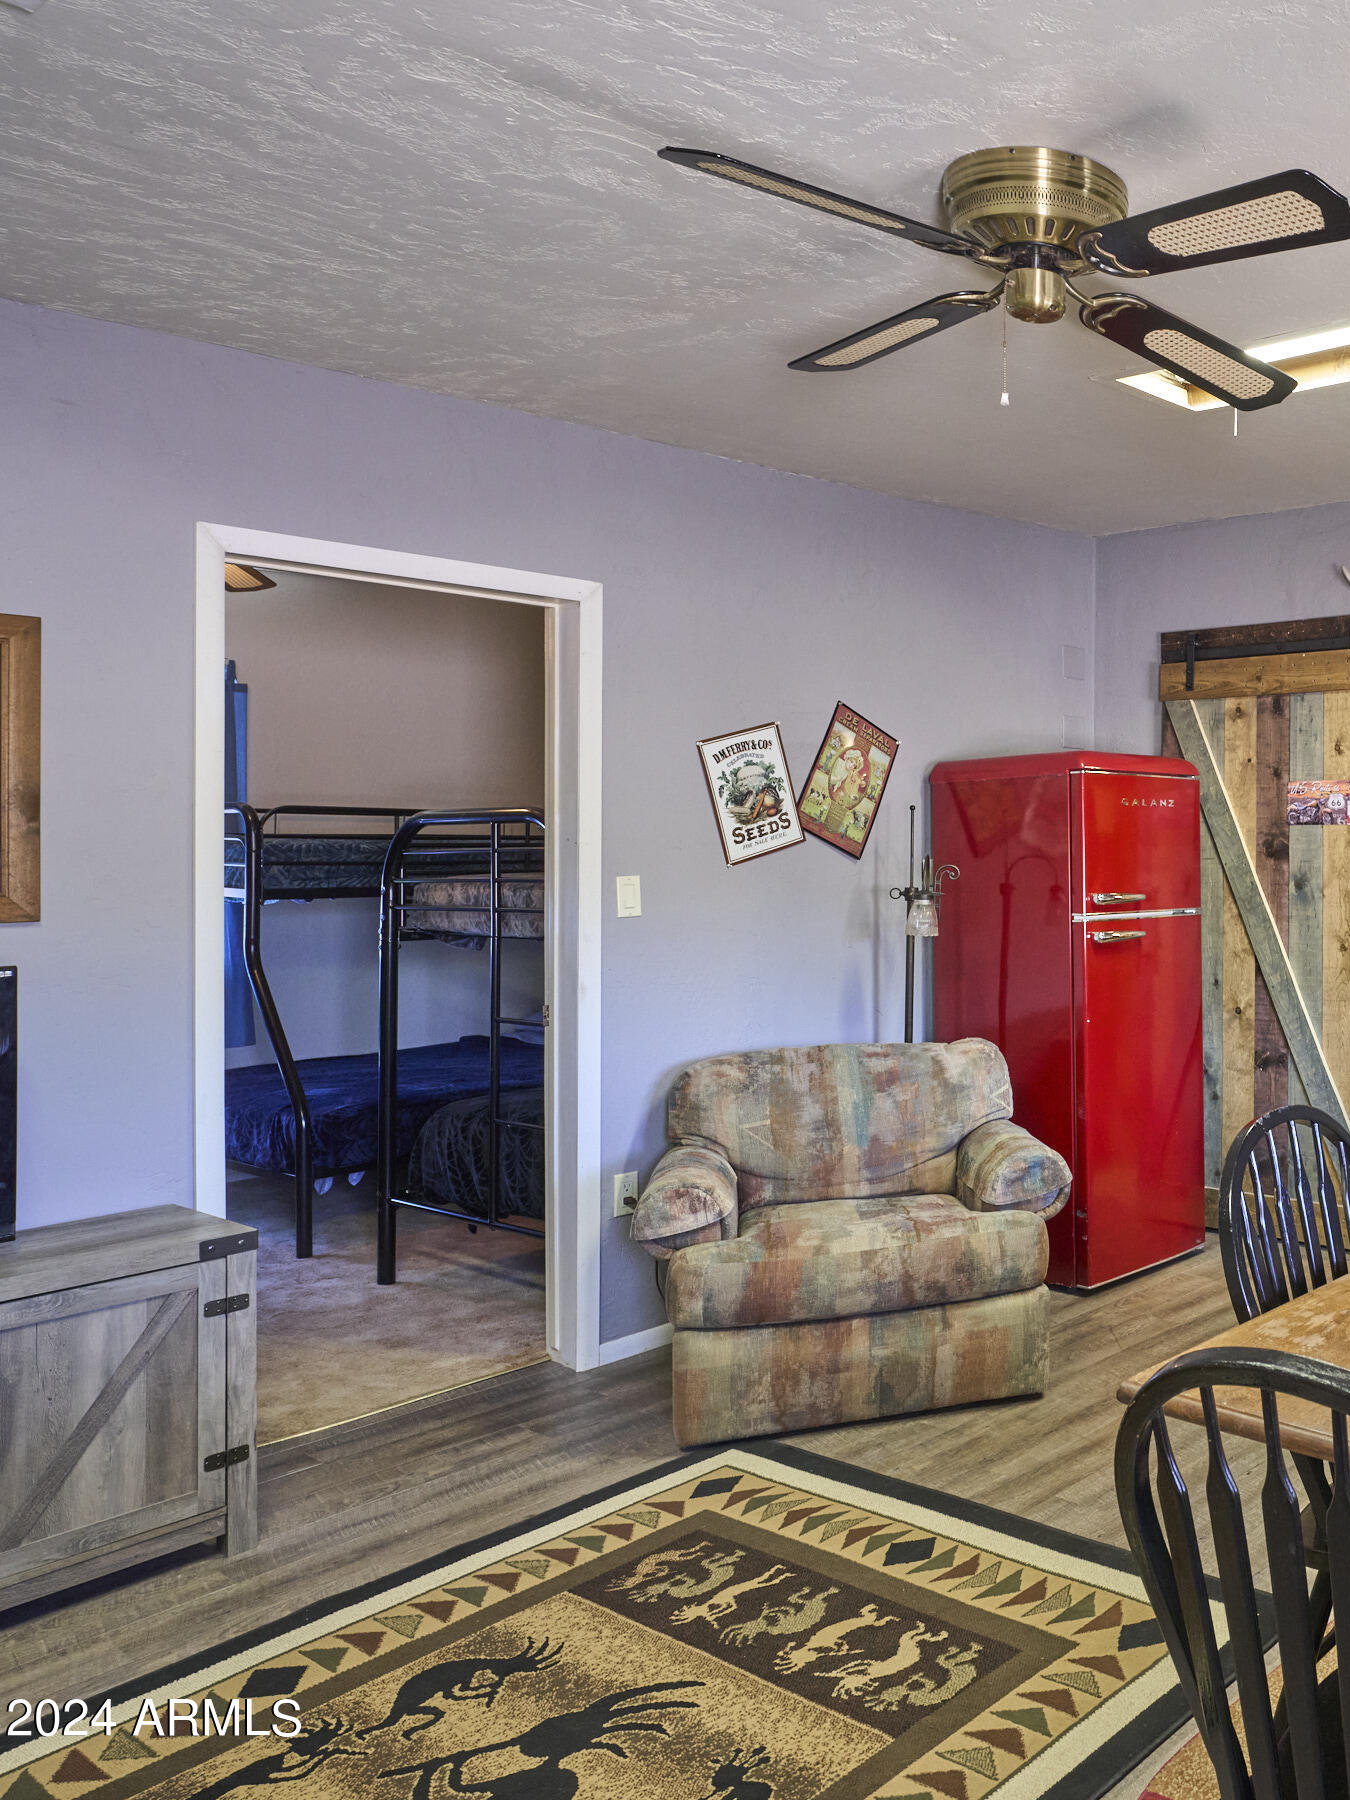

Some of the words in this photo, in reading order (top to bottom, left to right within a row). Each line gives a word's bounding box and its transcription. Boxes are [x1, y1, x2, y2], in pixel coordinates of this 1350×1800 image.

[845, 712, 859, 726] DE
[862, 723, 890, 748] LAVAL
[1121, 798, 1176, 808] GALANZ
[732, 811, 791, 844] SEEDS
